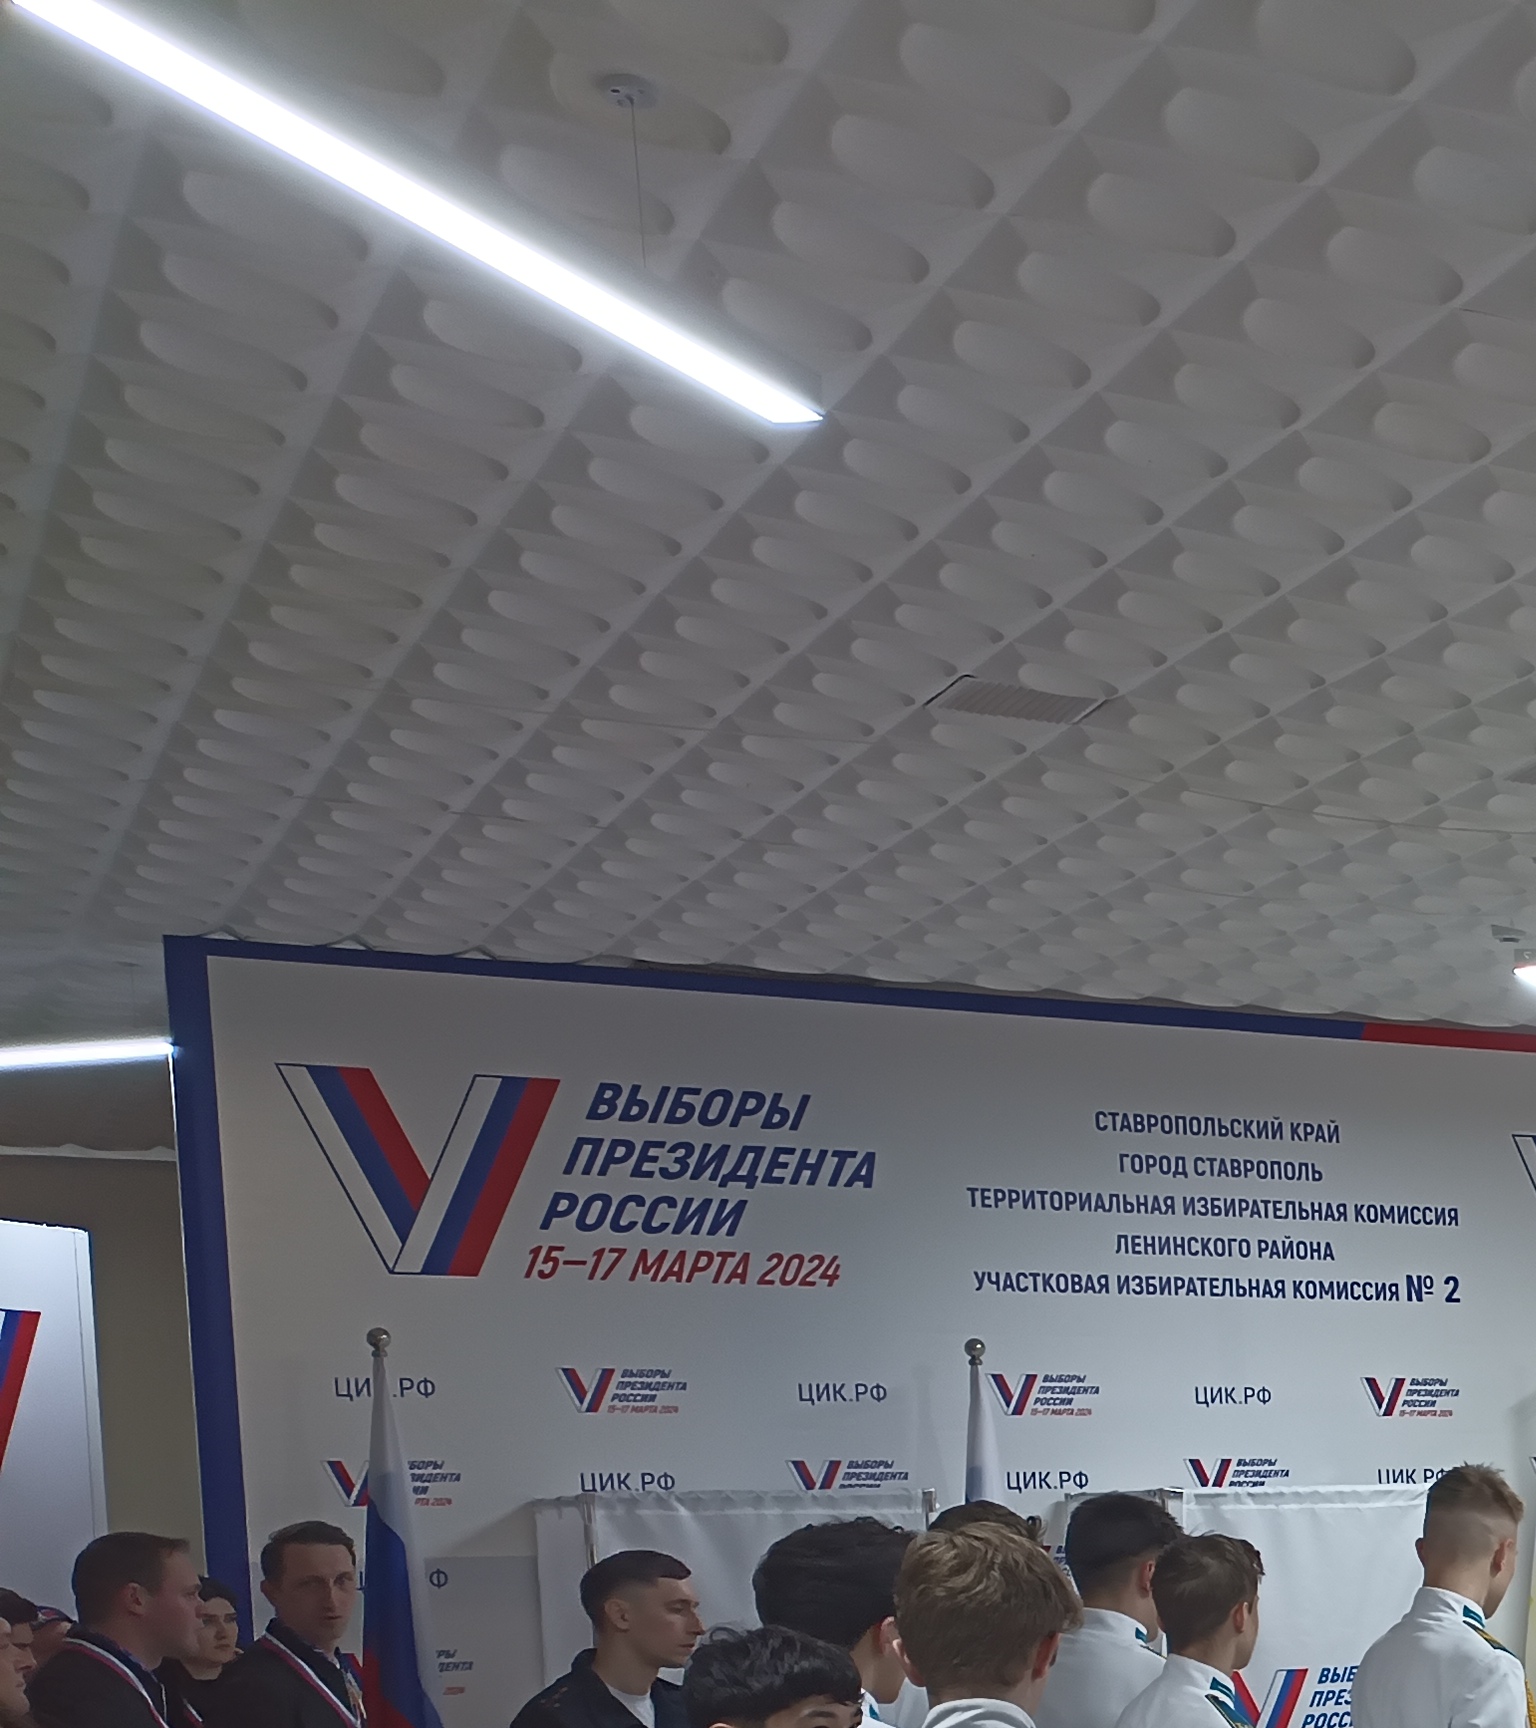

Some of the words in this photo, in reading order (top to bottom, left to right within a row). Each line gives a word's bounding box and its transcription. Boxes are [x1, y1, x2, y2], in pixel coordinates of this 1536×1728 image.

[586, 1082, 810, 1130] ВЫБОРЫ
[1095, 1111, 1284, 1140] СТАВРОПОЛЬСКИЙ
[1291, 1120, 1340, 1143] КРАЙ
[563, 1137, 876, 1189] ПРЕЗИДЕНТА
[1119, 1153, 1188, 1178] ГОРОД
[1194, 1156, 1323, 1181] СТАВРОПОЛЬ
[539, 1191, 748, 1237] РОССИИ
[967, 1187, 1175, 1215] ТЕРРИТОРИАЛЬНАЯ
[1183, 1197, 1347, 1222] ИЗБИРАТЕЛЬНАЯ
[1354, 1204, 1459, 1226] КОМИССИЯ
[1116, 1234, 1250, 1258] ЛЕНИНСКОГО
[1257, 1235, 1334, 1261] РАЙОНА
[524, 1245, 627, 1281] 15–17
[628, 1249, 751, 1284] МАРТА
[757, 1252, 840, 1287] 2024
[973, 1271, 1110, 1294] УЧАСТКОВАЯ
[1117, 1275, 1285, 1298] ИЗБИРАТЕЛЬНАЯ
[1292, 1280, 1399, 1301] КОМИССИЯ
[1406, 1274, 1434, 1302] №
[1444, 1276, 1460, 1303] 2
[621, 1369, 672, 1379] ВЫБОРЫ
[1042, 1374, 1086, 1383] ВЫБОРЫ
[334, 1377, 436, 1401] ЦИ.РФ
[616, 1381, 687, 1391] ПРЕЗИДЕНТА
[798, 1383, 887, 1405] ЦИК.РФ
[1038, 1386, 1099, 1395] ПРЕЗИДЕНТА
[1195, 1386, 1271, 1407] ЦИК.РФ
[1406, 1389, 1459, 1397] ПРЕЗИДЕНТА
[611, 1393, 657, 1402] РОССИИ
[1034, 1398, 1073, 1406] РОССИИ
[847, 1460, 894, 1469] ВЫБОРЫ
[1237, 1458, 1277, 1466] ВЫБОРЫ
[580, 1472, 675, 1492] ЦИК.РФ
[842, 1472, 908, 1481] ПРЕЗИДЕНТА
[1007, 1471, 1088, 1493] ЦИК.РФ
[1232, 1469, 1289, 1478] ПРЕЗИДЕНТА
